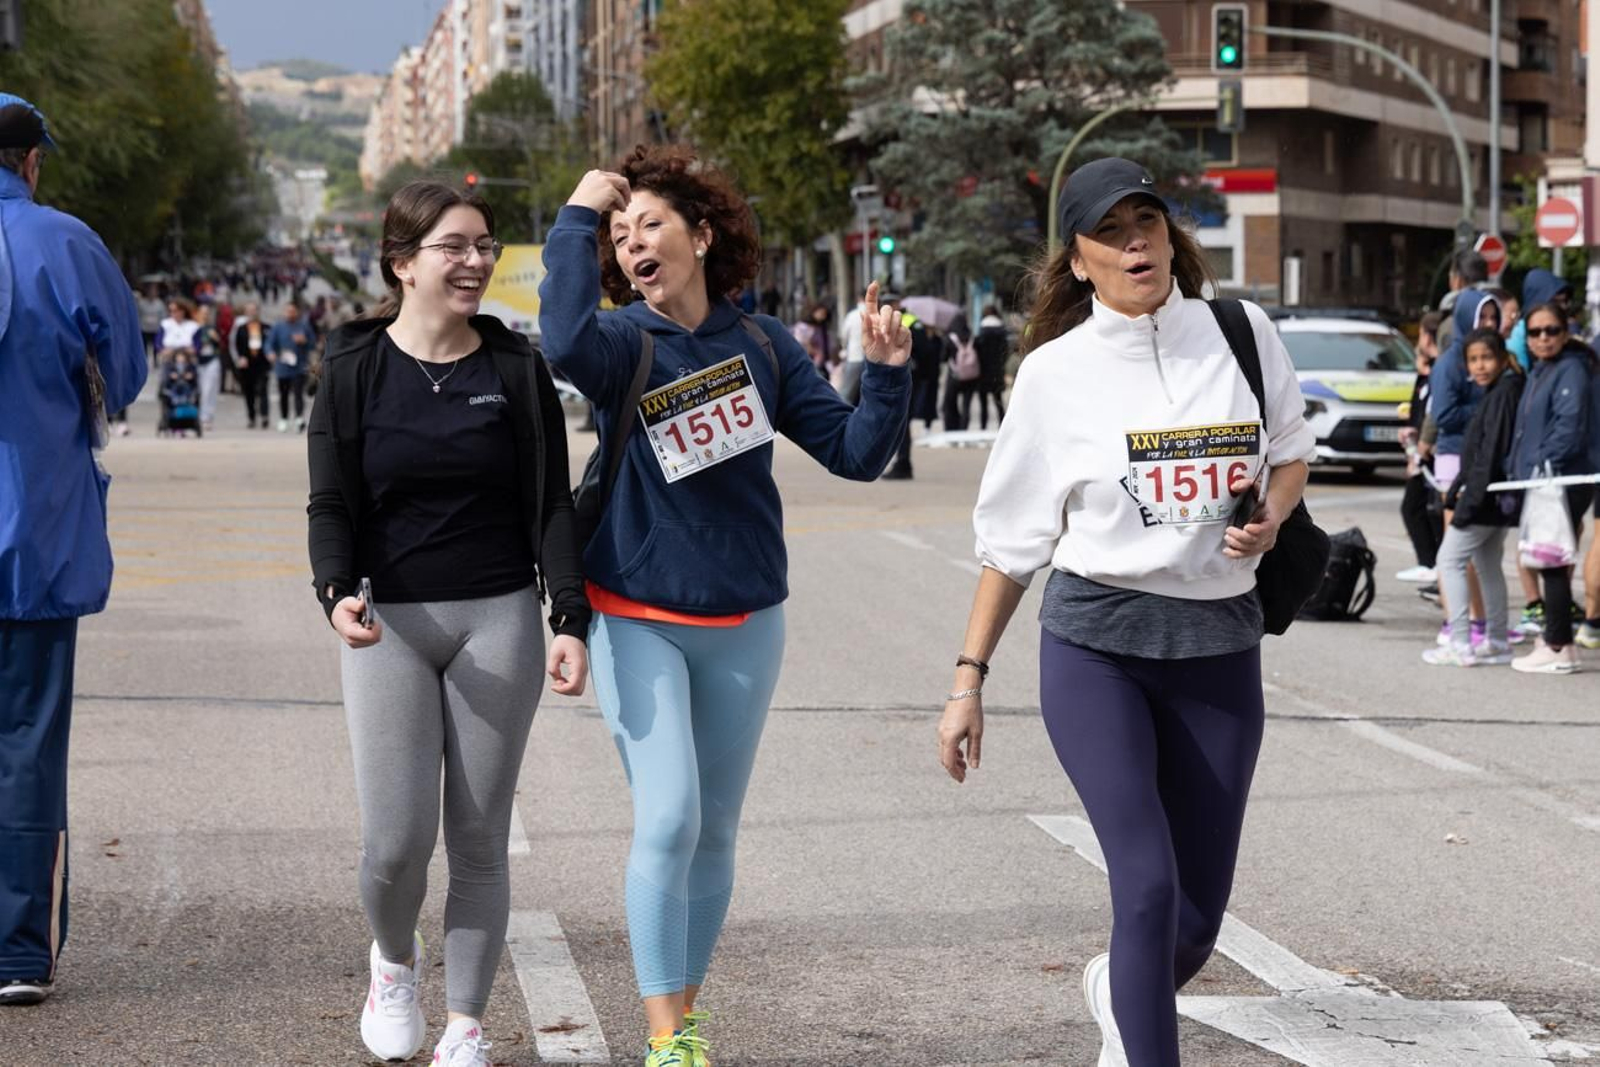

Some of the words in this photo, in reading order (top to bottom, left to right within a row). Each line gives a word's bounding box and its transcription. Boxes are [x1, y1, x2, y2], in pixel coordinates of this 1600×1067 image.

[642, 393, 668, 416] XXV
[668, 374, 706, 397] CARRERA
[706, 362, 742, 382] POPULAR
[681, 386, 704, 401] gran
[707, 369, 745, 389] caminata
[665, 394, 754, 454] 1515
[1131, 433, 1160, 450] XXV
[1161, 429, 1208, 441] CARRERA
[1210, 426, 1256, 436] POPULAR
[1162, 450, 1174, 458] LA
[1194, 448, 1206, 456] LA
[1175, 438, 1203, 449] gran
[1208, 433, 1257, 444] caminata
[1145, 461, 1248, 503] 1516
